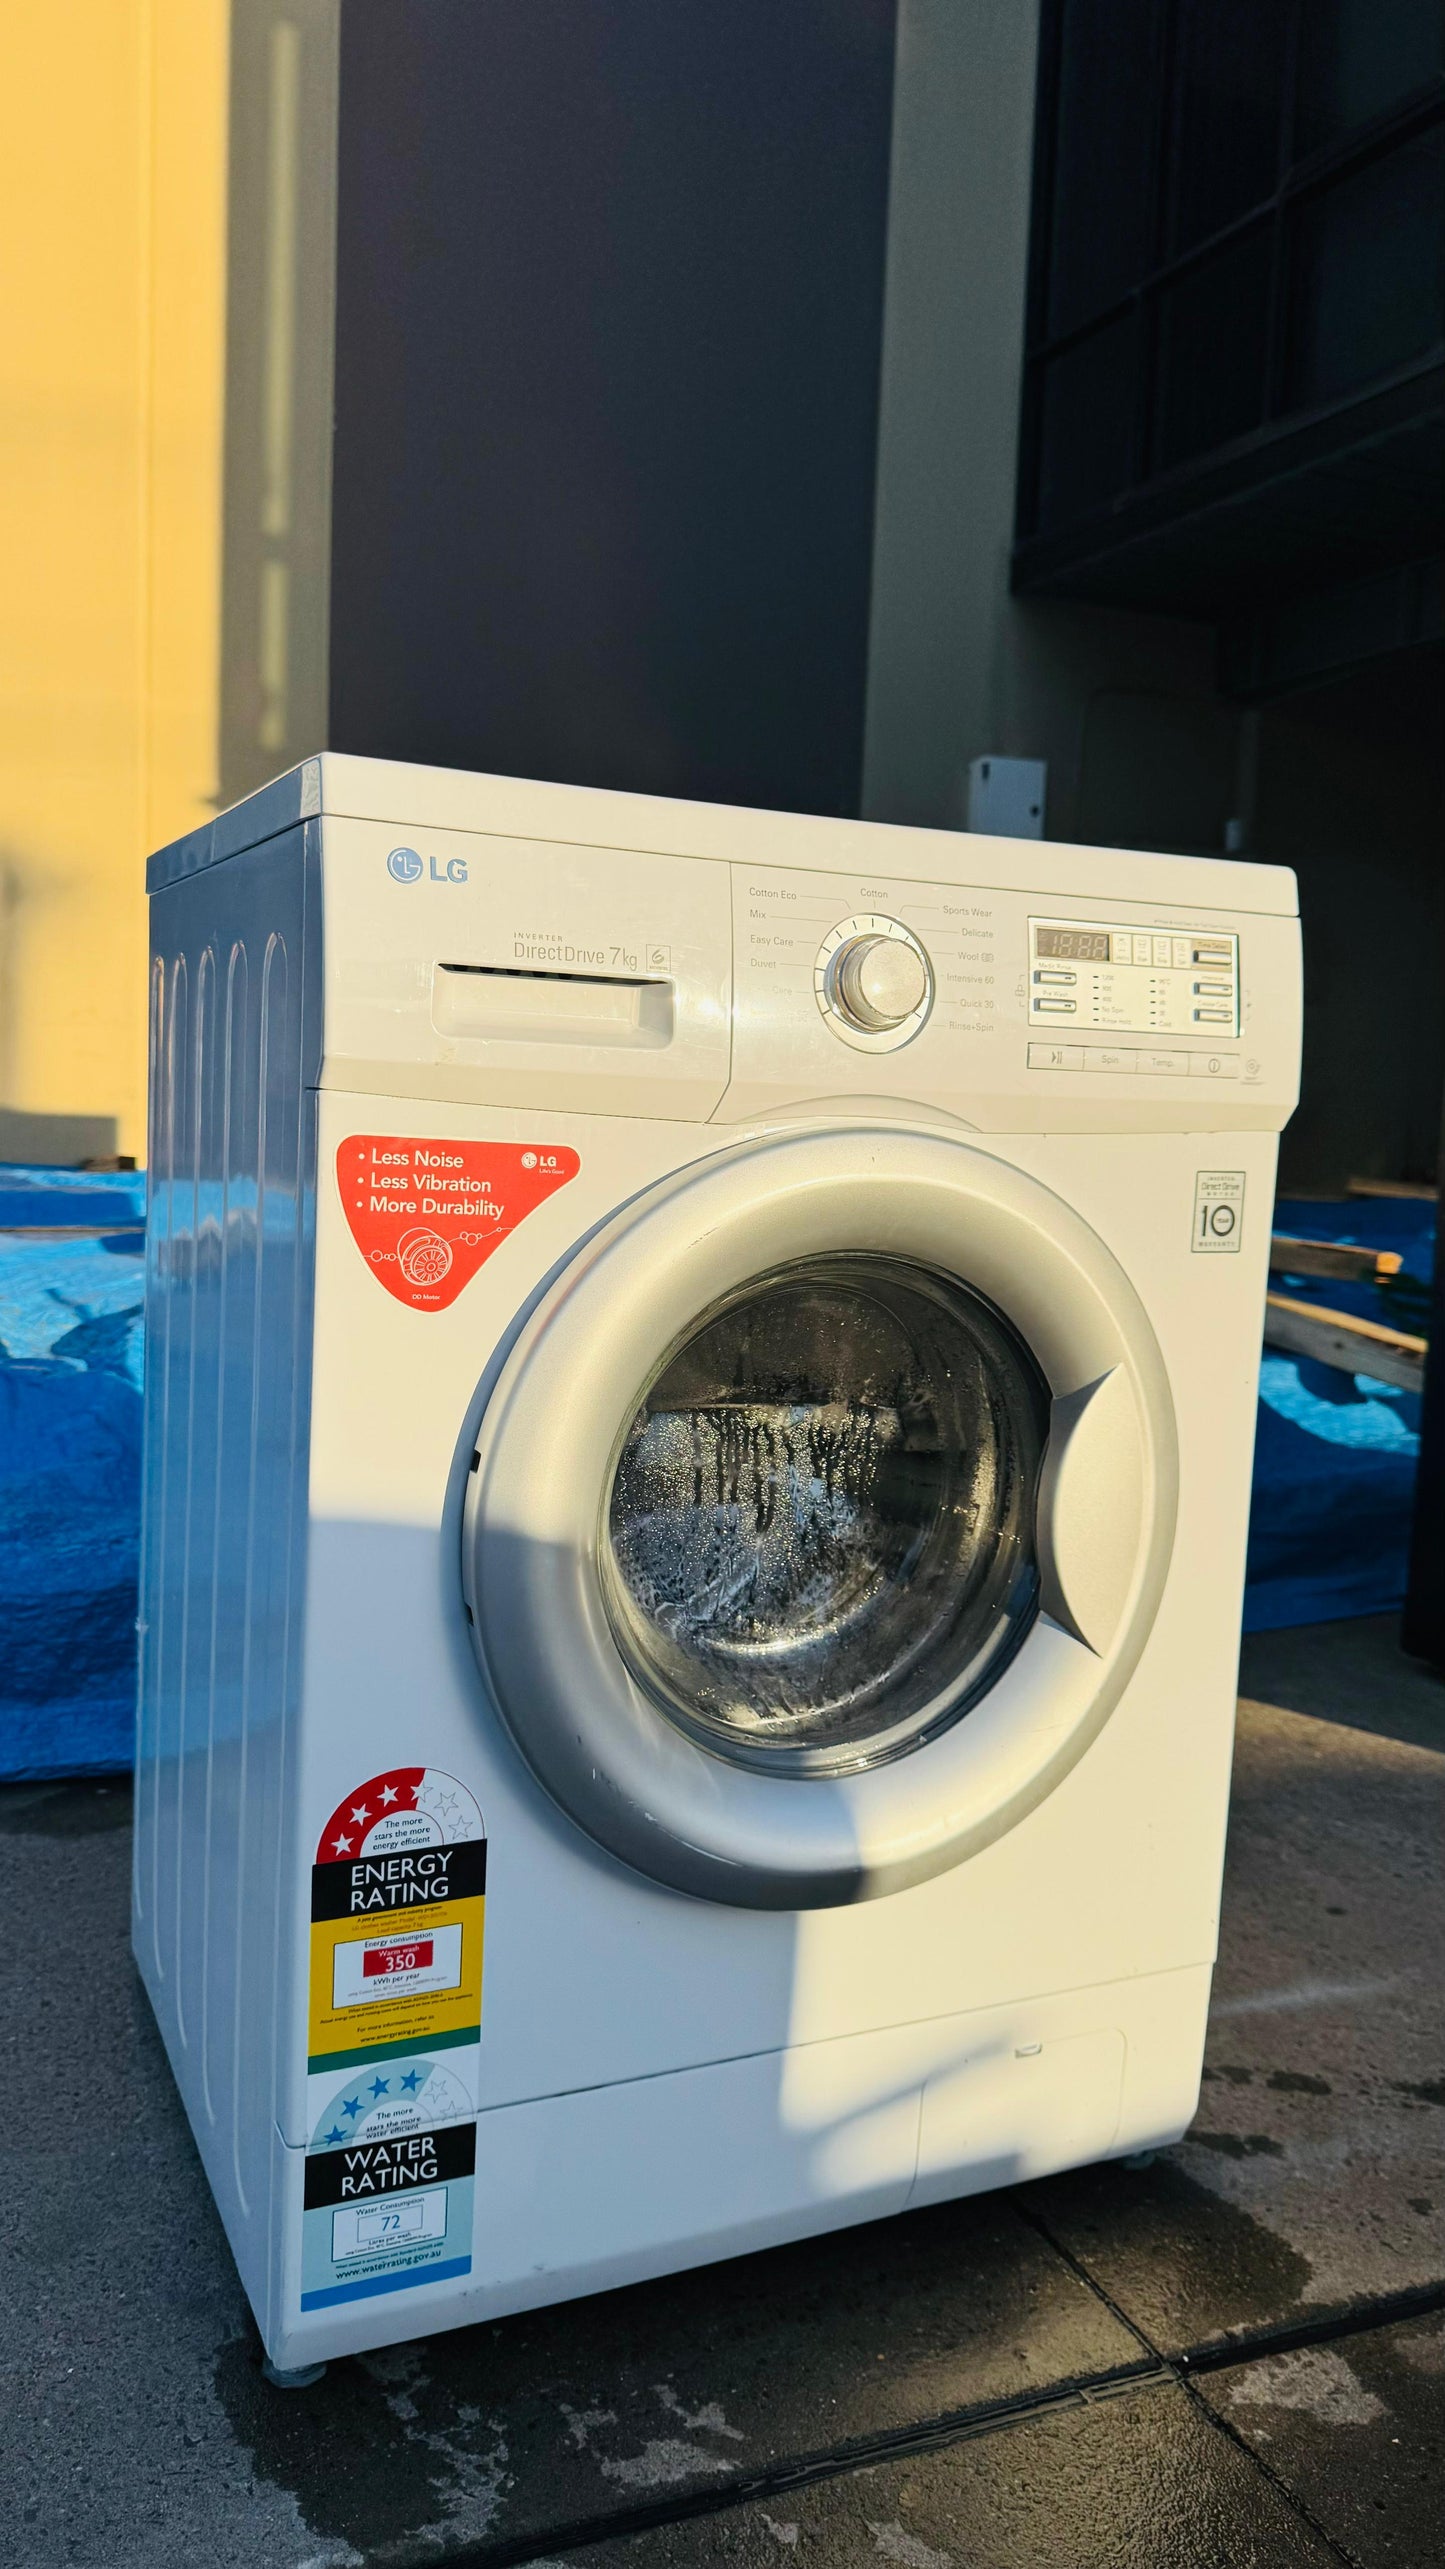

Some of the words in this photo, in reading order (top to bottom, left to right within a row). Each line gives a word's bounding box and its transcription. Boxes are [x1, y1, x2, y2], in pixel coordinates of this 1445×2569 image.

[430, 856, 468, 884] LG
[749, 887, 779, 900] Cotton
[781, 890, 797, 900] Eco
[860, 888, 888, 899] Cotton
[750, 909, 767, 919] Mix
[943, 905, 970, 917] Sports
[971, 907, 992, 918] Wear
[513, 932, 563, 942] INVERTER
[962, 928, 994, 939] Delicate
[750, 934, 772, 947] Easy
[773, 936, 794, 947] Care
[958, 951, 979, 962] Wool
[750, 958, 777, 969] Duvet
[946, 974, 983, 985] Intensive
[984, 975, 995, 985] 60
[960, 998, 983, 1009] Quick
[984, 1000, 994, 1009] 30
[949, 1021, 994, 1033] Rinse+Spin
[1101, 1054, 1119, 1065] Spin
[371, 1148, 409, 1166] Less
[414, 1150, 464, 1168] Noise
[540, 1155, 557, 1168] LG
[370, 1172, 408, 1189] Less
[412, 1173, 492, 1193] Vibration
[1201, 1182, 1221, 1190] Direct
[1222, 1182, 1240, 1191] Drive
[370, 1196, 417, 1214] More
[422, 1198, 505, 1221] Durability
[1202, 1205, 1235, 1237] 10
[384, 1820, 400, 1829] The
[401, 1817, 423, 1826] more
[374, 1831, 393, 1841] stars
[395, 1829, 408, 1838] the
[409, 1826, 430, 1836] more
[373, 1840, 398, 1851] energy
[400, 1836, 431, 1846] efficient
[352, 1851, 453, 1887] ENERGY
[351, 1877, 449, 1912] RATING
[364, 1939, 388, 1949] Energy
[389, 1932, 433, 1944] consumption
[379, 1949, 401, 1957] Warm
[402, 1945, 420, 1953] wash
[385, 1953, 416, 1973] 350
[373, 1977, 391, 1986] kWh
[392, 1976, 405, 1984] per
[406, 1972, 420, 1981] year
[414, 2015, 427, 2023] refer
[376, 2111, 391, 2120] The
[393, 2108, 413, 2117] more
[366, 2123, 384, 2133] stars
[386, 2120, 399, 2128] the
[400, 2116, 421, 2125] more
[366, 2129, 387, 2139] water
[390, 2123, 419, 2134] efficient
[344, 2137, 436, 2171] WATER
[342, 2159, 438, 2197] RATING
[355, 2206, 378, 2216] Water
[380, 2197, 425, 2211] Consumption
[381, 2214, 401, 2231] 72
[386, 2235, 397, 2244] per
[336, 2250, 442, 2279] www.waterrating.gov.au
